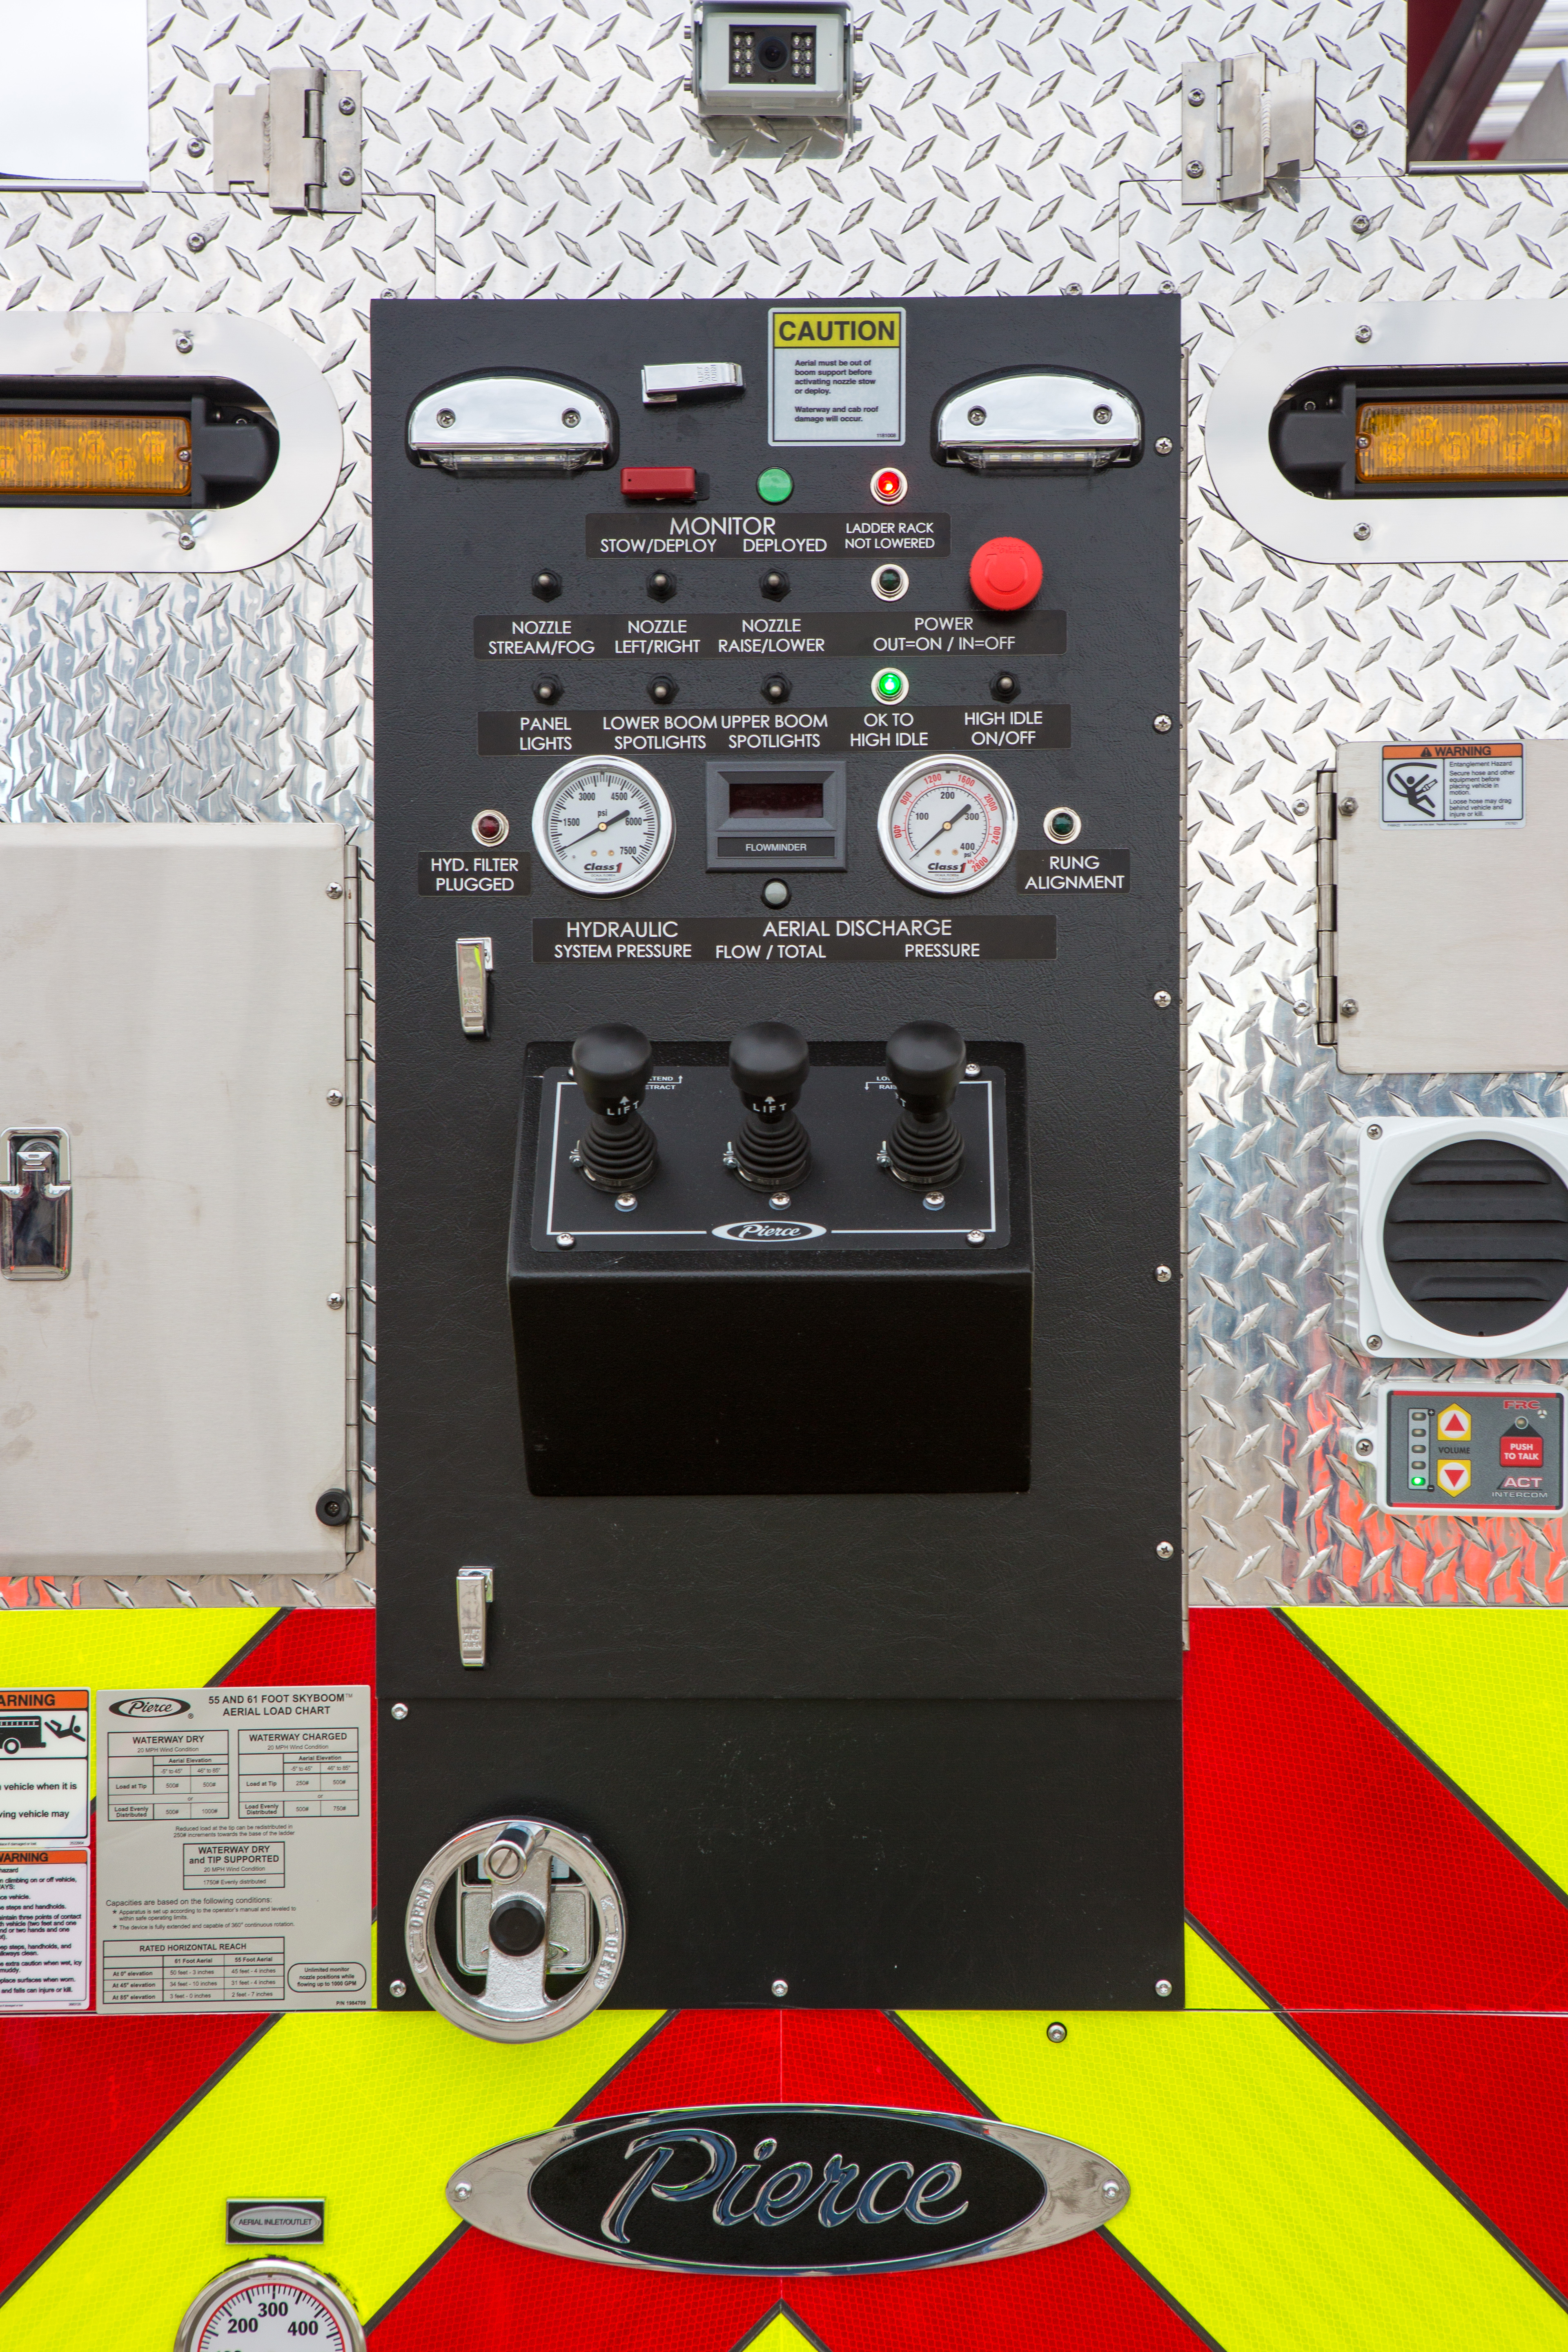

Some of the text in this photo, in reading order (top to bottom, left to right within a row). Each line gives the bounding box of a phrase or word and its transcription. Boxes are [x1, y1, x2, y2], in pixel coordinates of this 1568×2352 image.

[780, 321, 894, 341] CAUTION
[670, 517, 775, 535] MONITOR
[846, 523, 934, 533] LADDER RACK
[601, 539, 717, 553] STOW/DEPLOY
[744, 539, 827, 552] DEPLOYED
[845, 538, 935, 548] NOT LOWERED
[512, 621, 571, 634] NOZZLE
[628, 620, 687, 633] NOZZLE
[742, 619, 801, 632] NOZZLE
[915, 617, 973, 630] POWER
[489, 640, 595, 655] STREAM/FOG
[615, 640, 700, 654] LEFT/RIGHT
[719, 639, 824, 653] RAISE/LOWER
[873, 637, 1015, 651] OUT=ON / IN=OFF
[521, 717, 571, 730] PANEL
[604, 716, 717, 730] LOWER BOOM
[722, 714, 828, 728] UPPER BOOM
[864, 713, 913, 726] OK TO
[965, 711, 1042, 725] HIGH IDLE
[520, 737, 572, 750] LIGHTS
[615, 735, 706, 749] SPOTLIGHTS
[729, 734, 820, 748] SPOTLIGHTS
[851, 733, 928, 746] HIGH IDLE
[971, 731, 1036, 746] ON/OFF
[1435, 746, 1492, 756] WARNING
[924, 773, 941, 784] 1200
[958, 774, 975, 787] 1600
[900, 791, 912, 805] 800
[940, 791, 955, 800] 200
[984, 794, 997, 811] 2000
[598, 809, 607, 818] psi
[563, 818, 580, 827] 1500
[625, 817, 642, 826] 6000
[991, 826, 1001, 844] 2400
[620, 846, 636, 856] 7500
[432, 858, 518, 871] HYD. FILTER
[972, 857, 988, 872] 2800
[1050, 856, 1099, 869] RUNG
[437, 878, 514, 891] PLUGGED
[1025, 875, 1125, 889] ALIGNMENT
[567, 921, 678, 937] HYDRAULIC
[763, 920, 951, 936] AERIAL DISCHARGE
[555, 944, 691, 958] SYSTEM PRESSURE
[716, 945, 826, 960] FLOW / TOTAL
[906, 944, 980, 957] PRESSURE
[607, 1100, 641, 1115] LIFT
[753, 1103, 786, 1113] LIFT
[738, 1224, 801, 1238] Pierce
[1503, 1400, 1541, 1410] FRC
[1501, 1478, 1542, 1489] ACT
[128, 1699, 173, 1714] Pierce
[223, 1708, 260, 1716] AERIAL
[601, 2128, 969, 2243] Pierce
[258, 2302, 288, 2317] 300
[228, 2318, 258, 2333] 200
[288, 2321, 318, 2336] 400
